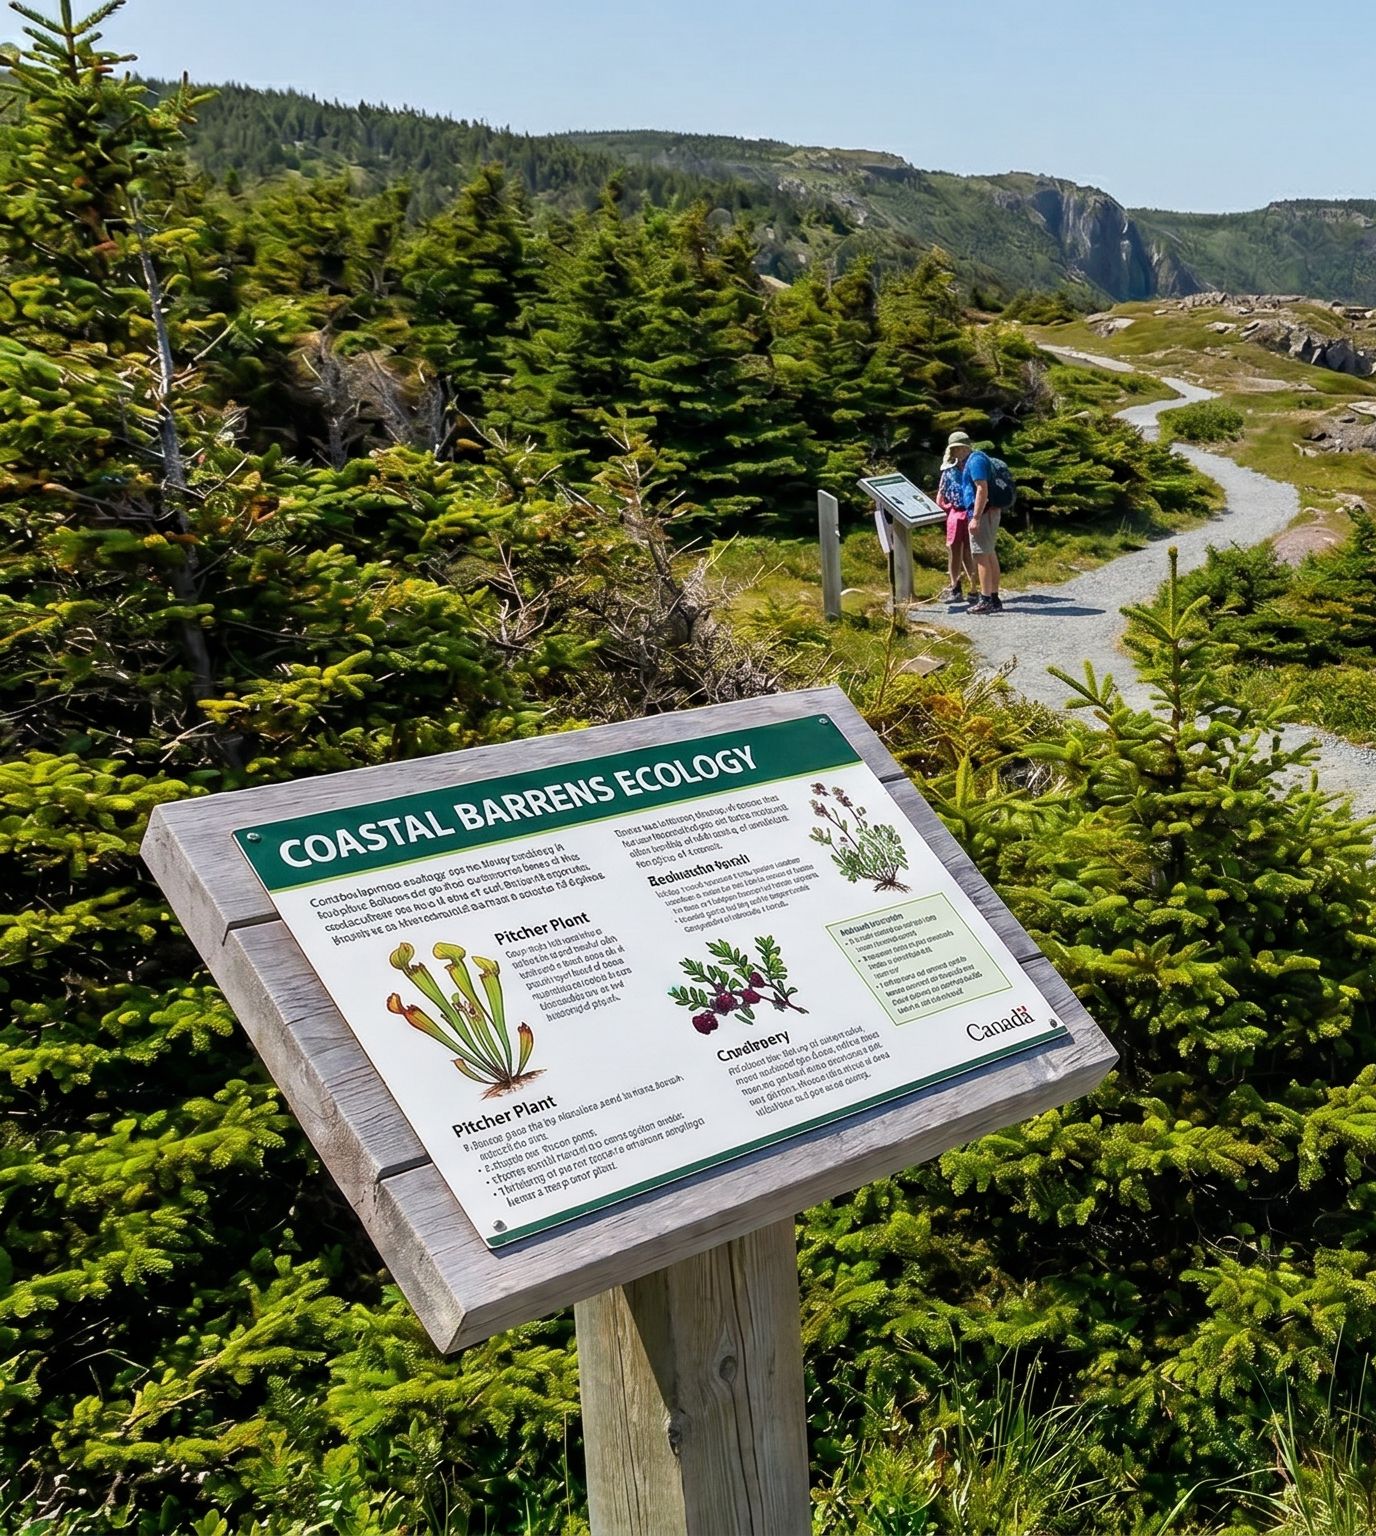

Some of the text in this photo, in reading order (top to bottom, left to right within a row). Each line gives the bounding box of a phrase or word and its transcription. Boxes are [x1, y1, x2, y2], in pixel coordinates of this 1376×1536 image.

[280, 746, 756, 867] COASTAL BARRENS ECOLOGY
[495, 924, 548, 945] Pitcher
[967, 1006, 1035, 1041] Canada
[452, 1096, 557, 1138] Pitcher Plant
